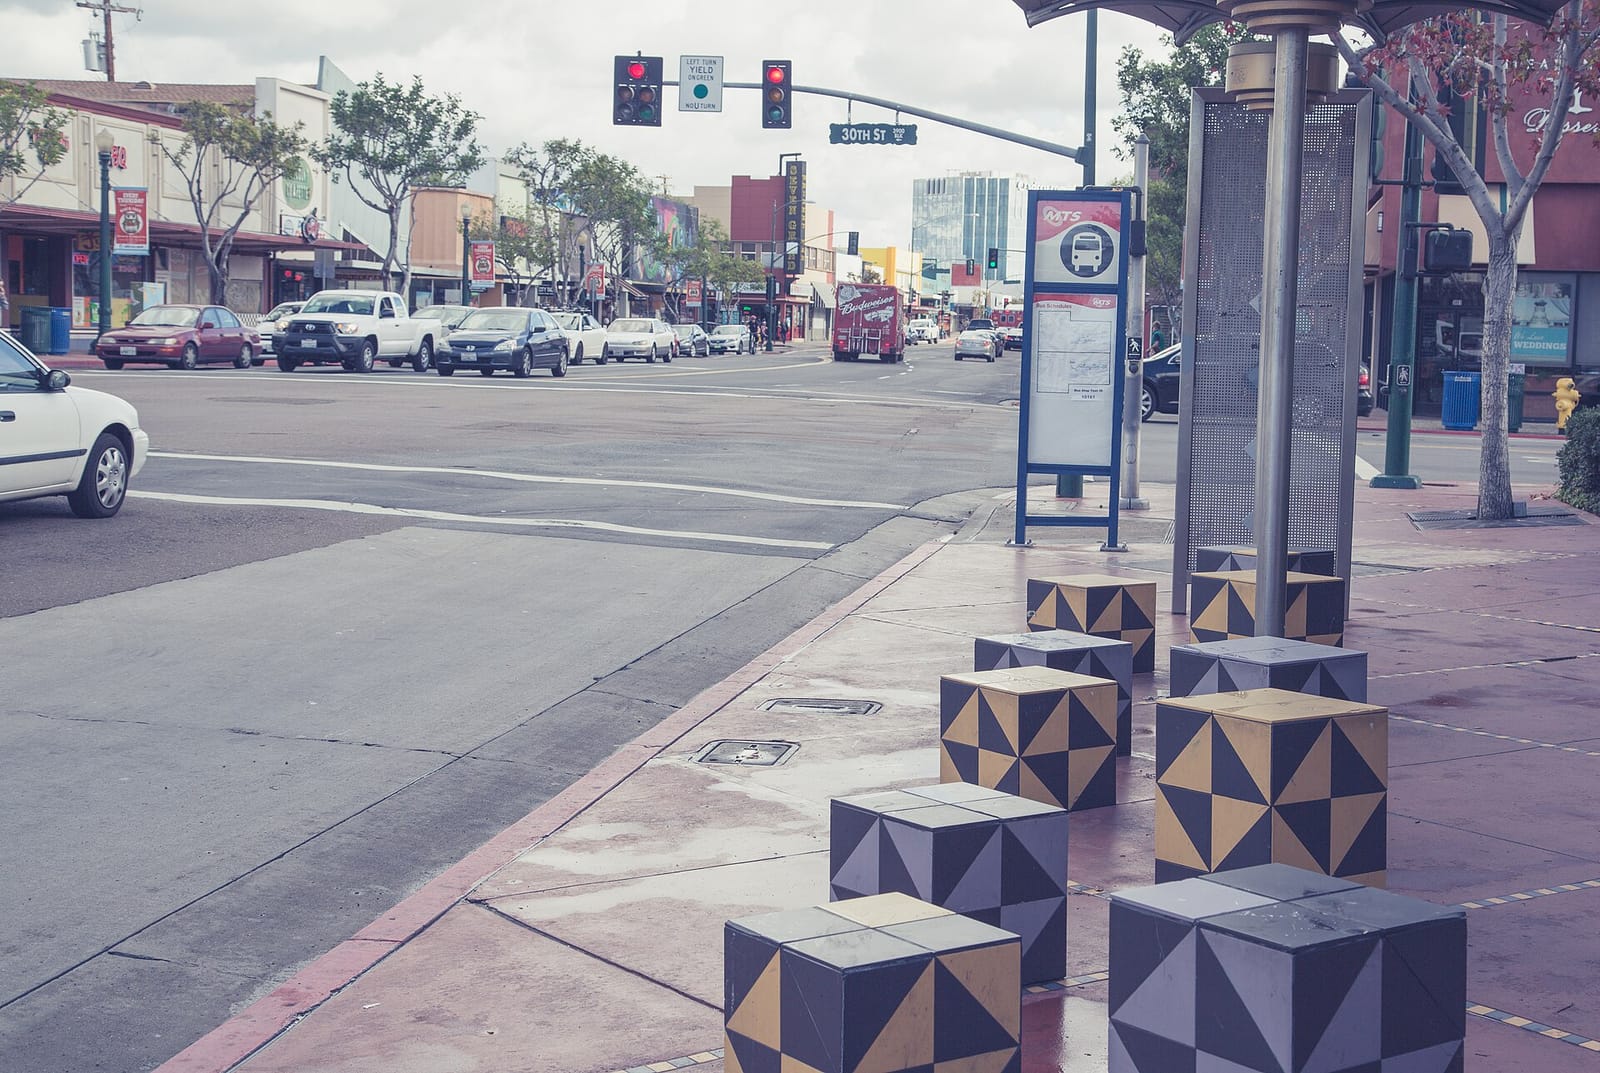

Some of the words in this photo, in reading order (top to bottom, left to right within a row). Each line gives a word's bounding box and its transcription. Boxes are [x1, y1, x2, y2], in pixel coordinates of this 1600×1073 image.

[690, 66, 713, 74] YIELD
[841, 128, 871, 141] 30TH
[873, 128, 886, 141] ST
[1045, 209, 1082, 223] MTS
[840, 296, 895, 315] Budweiser
[1514, 341, 1567, 350] WEDDINGS
